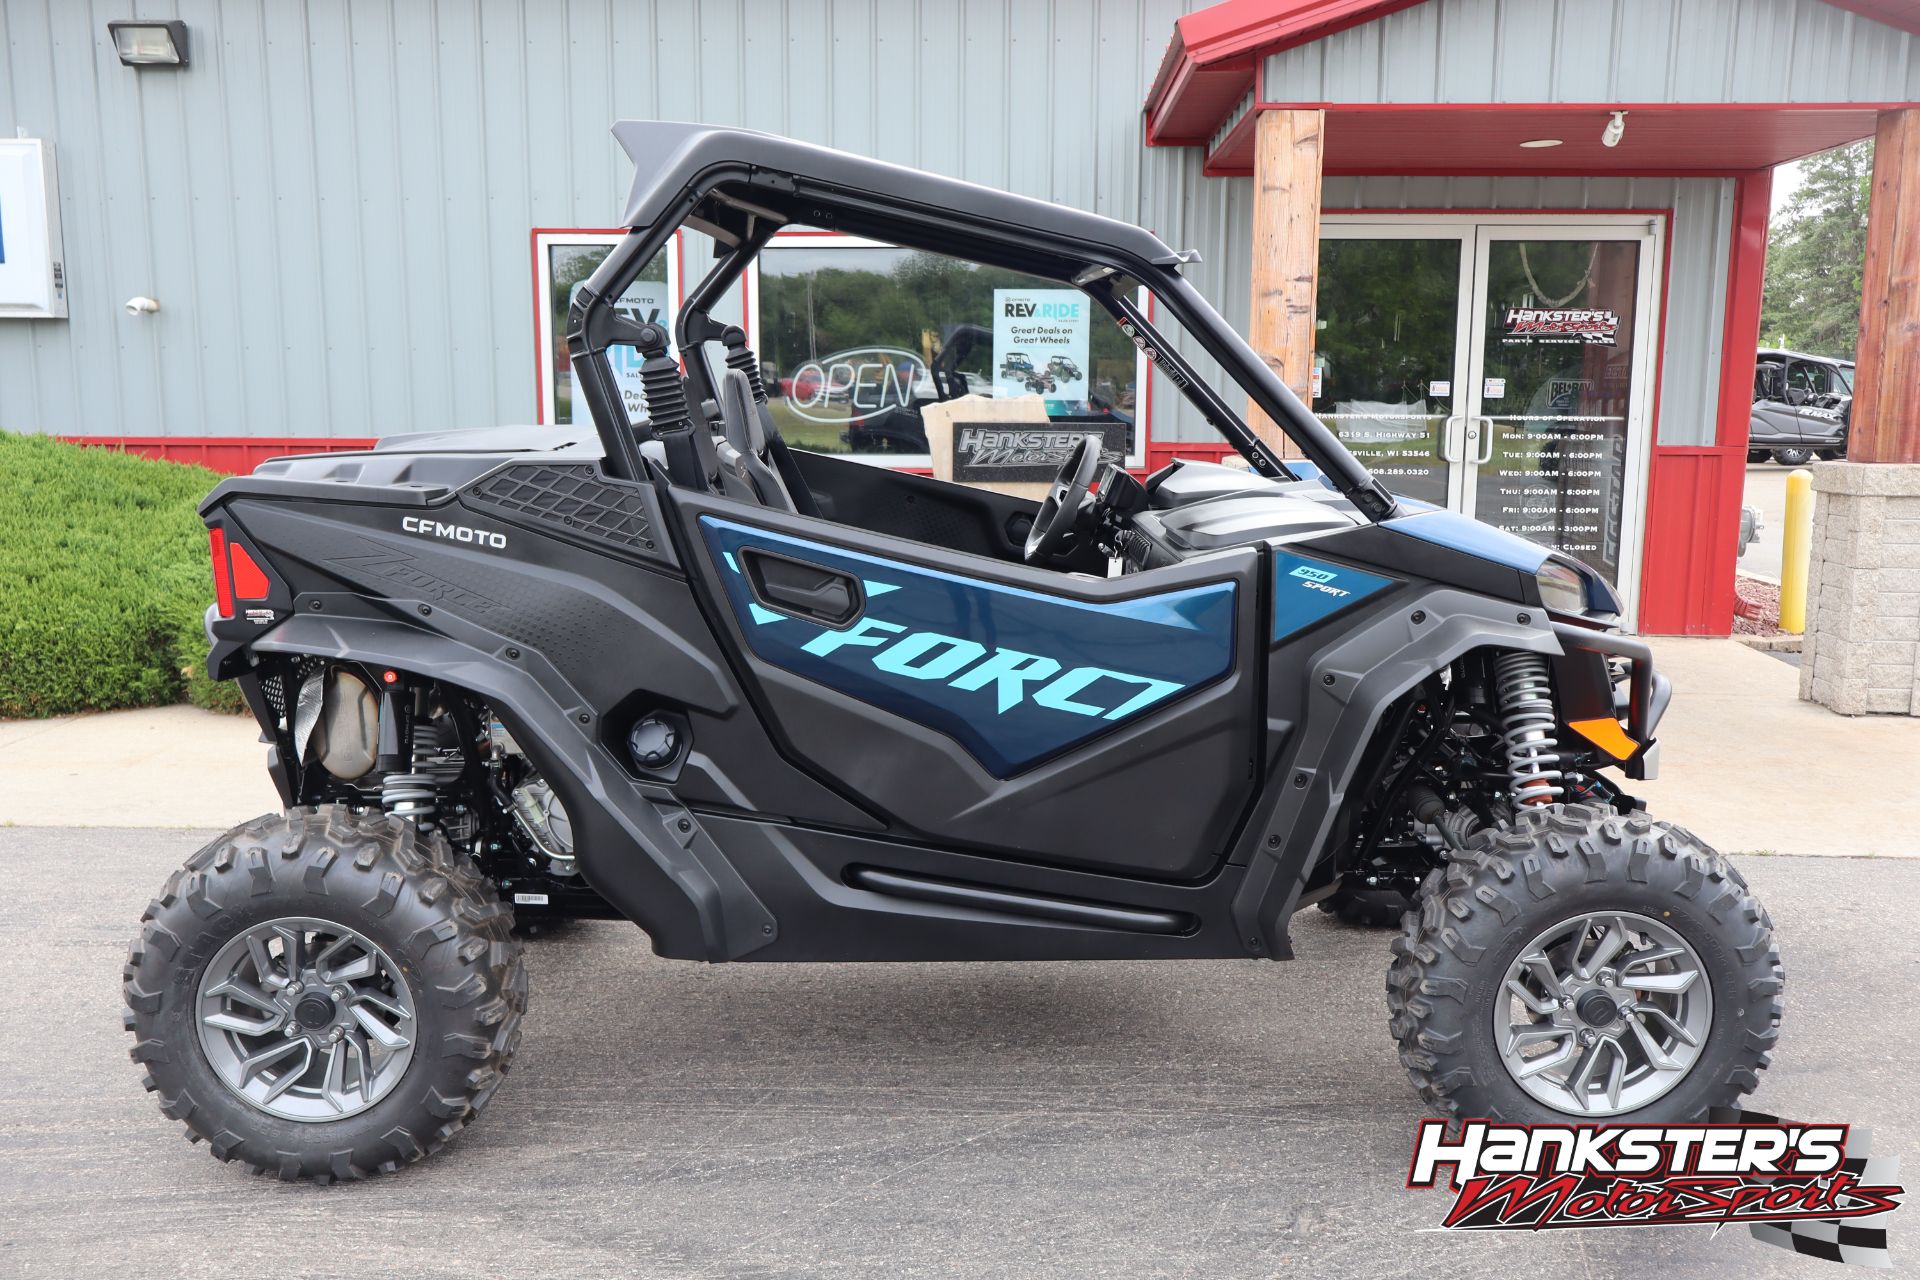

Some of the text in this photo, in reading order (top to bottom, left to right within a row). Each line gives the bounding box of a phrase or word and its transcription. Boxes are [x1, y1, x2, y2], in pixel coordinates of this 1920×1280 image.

[1004, 303, 1037, 318] REV
[1042, 303, 1080, 320] RIDE
[1010, 326, 1036, 335] Great
[1037, 326, 1060, 335] Deals
[1013, 336, 1071, 345] Great Wheels
[792, 363, 915, 409] OPEN
[1555, 414, 1606, 422] OPERATION
[1376, 431, 1417, 439] HIGHWAY
[402, 516, 507, 549] CFMOTO
[1298, 568, 1329, 581] 950
[1302, 580, 1351, 597] SPORT
